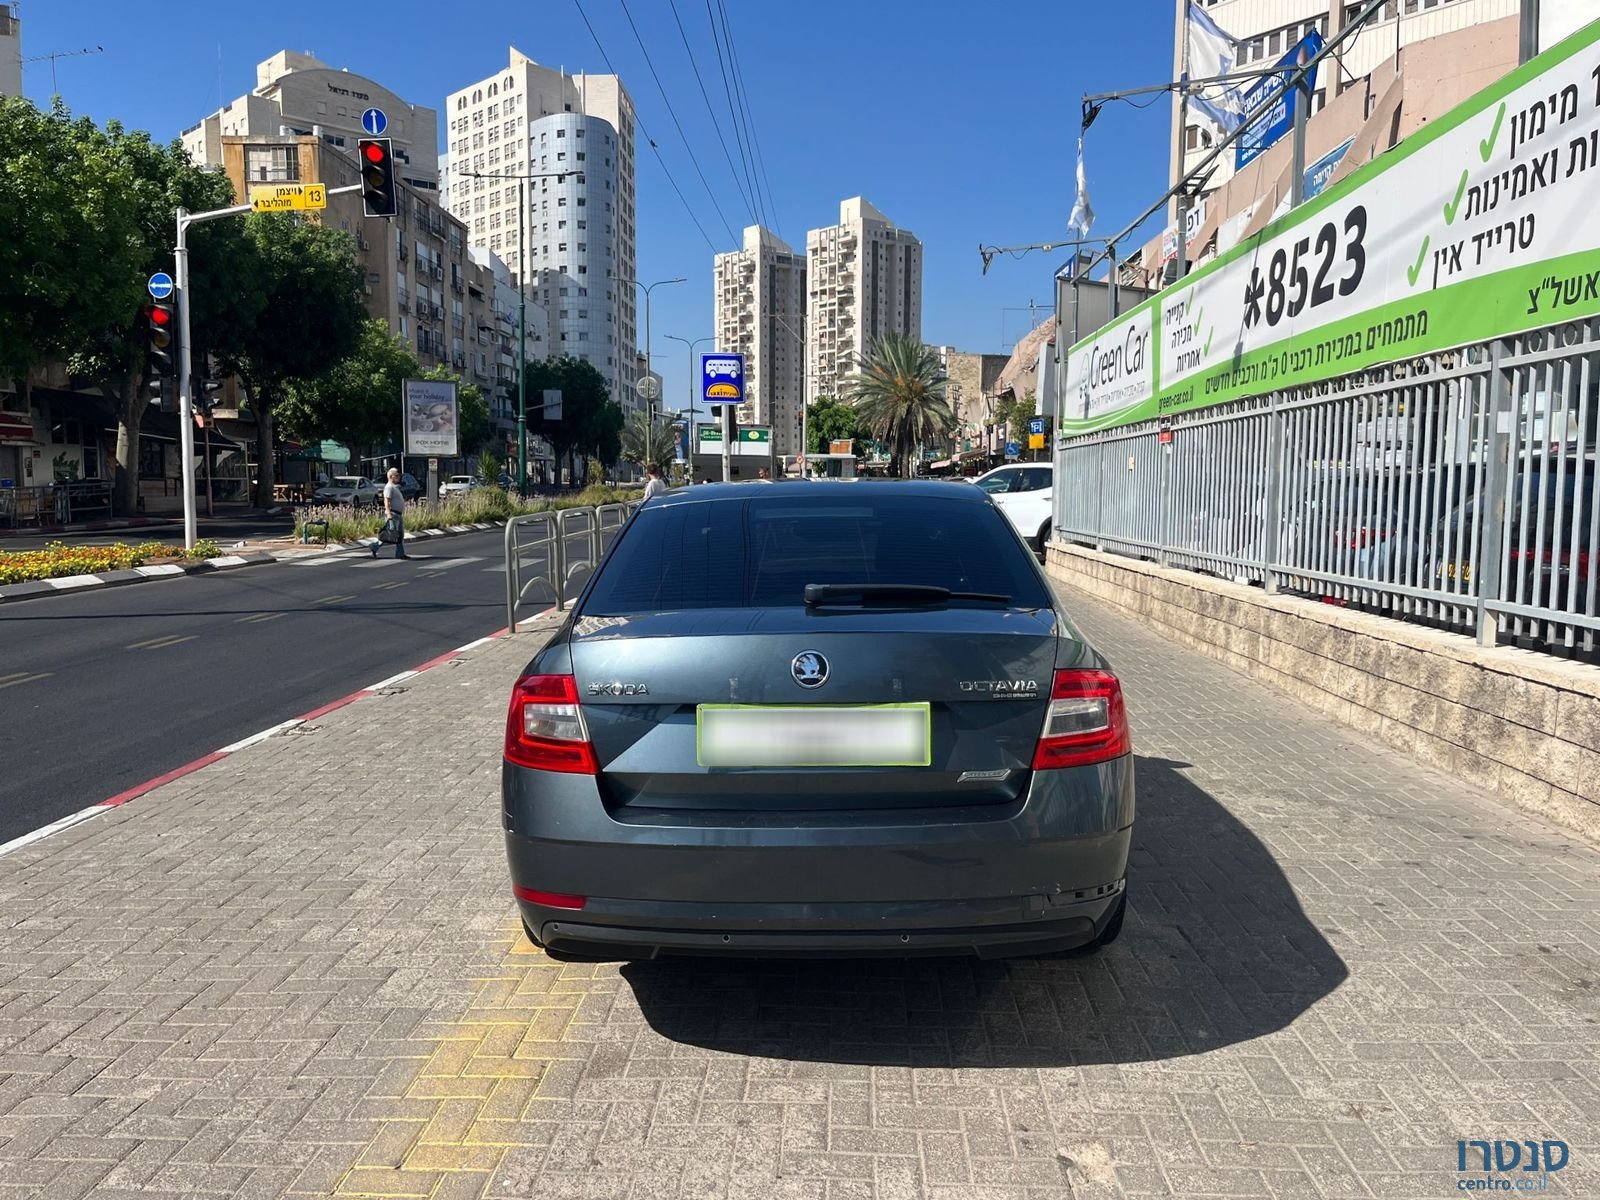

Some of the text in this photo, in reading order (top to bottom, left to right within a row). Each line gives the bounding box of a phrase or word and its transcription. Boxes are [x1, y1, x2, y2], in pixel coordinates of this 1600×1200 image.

[1510, 83, 1578, 160] מימון
[1464, 129, 1600, 221] ות ואמינות
[260, 197, 292, 208] מוהליבר
[276, 187, 297, 198] ויצמן
[308, 190, 321, 203] 13
[1433, 213, 1535, 290] טרייד אין
[1527, 270, 1600, 315] אשל"צ
[1166, 301, 1184, 326] קנייה
[1171, 325, 1192, 349] מכירה
[1366, 309, 1428, 351] מתמחים
[1091, 324, 1148, 390] Green Car
[1176, 347, 1201, 373] אחריות
[1290, 347, 1312, 372] רכבי
[1314, 331, 1361, 367] במכירת
[1232, 363, 1259, 387] ורכבים
[1281, 351, 1288, 375] 0
[1205, 372, 1230, 394] חדשים
[1159, 385, 1194, 414] green-car.co.il
[588, 682, 650, 696] ŠKODA
[959, 680, 1039, 692] OCTAVIA
